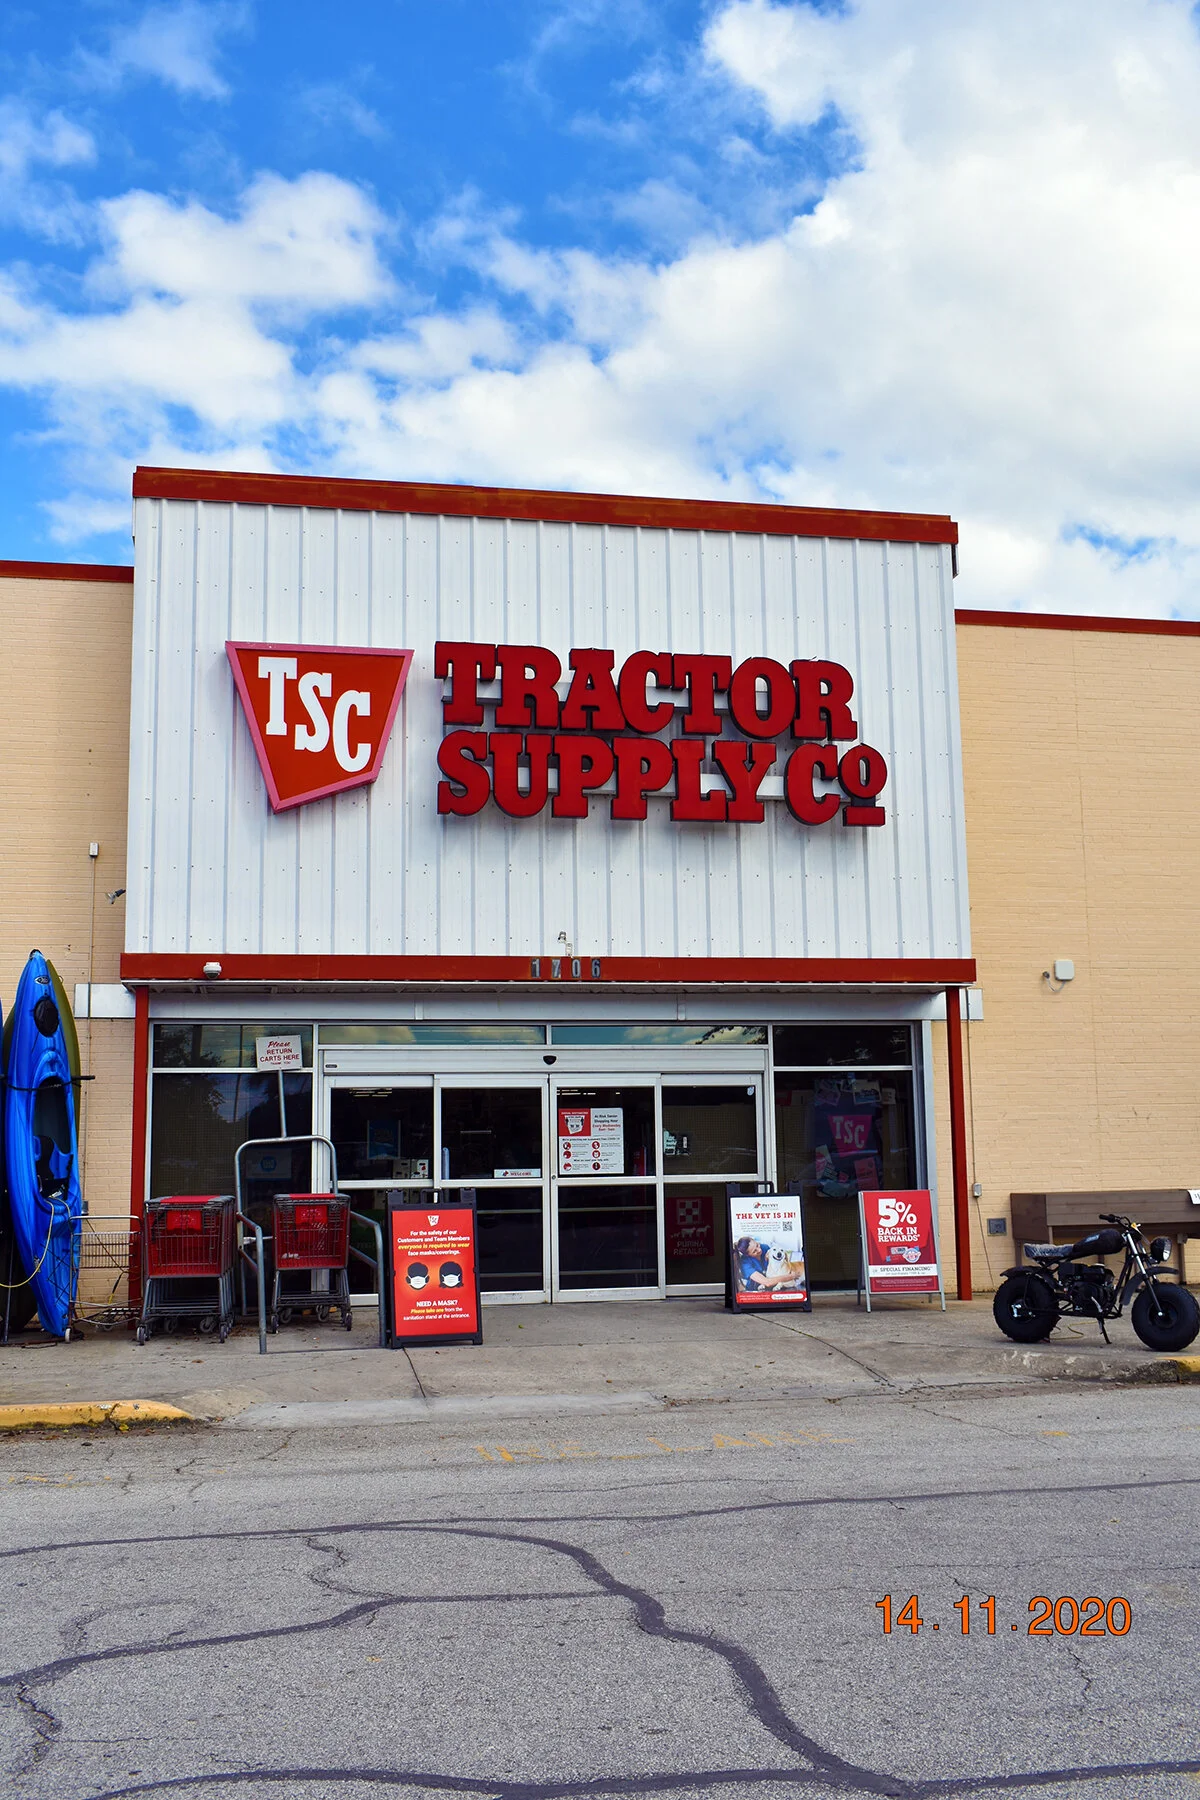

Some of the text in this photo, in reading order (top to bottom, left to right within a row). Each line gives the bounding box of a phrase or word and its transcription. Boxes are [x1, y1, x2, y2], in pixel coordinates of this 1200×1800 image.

[258, 656, 371, 773] TSC
[434, 641, 857, 741] TRACTOR
[437, 730, 777, 823] SUPPLY
[532, 958, 600, 978] 1706
[833, 1116, 865, 1149] TSC
[878, 1198, 917, 1228] 5%
